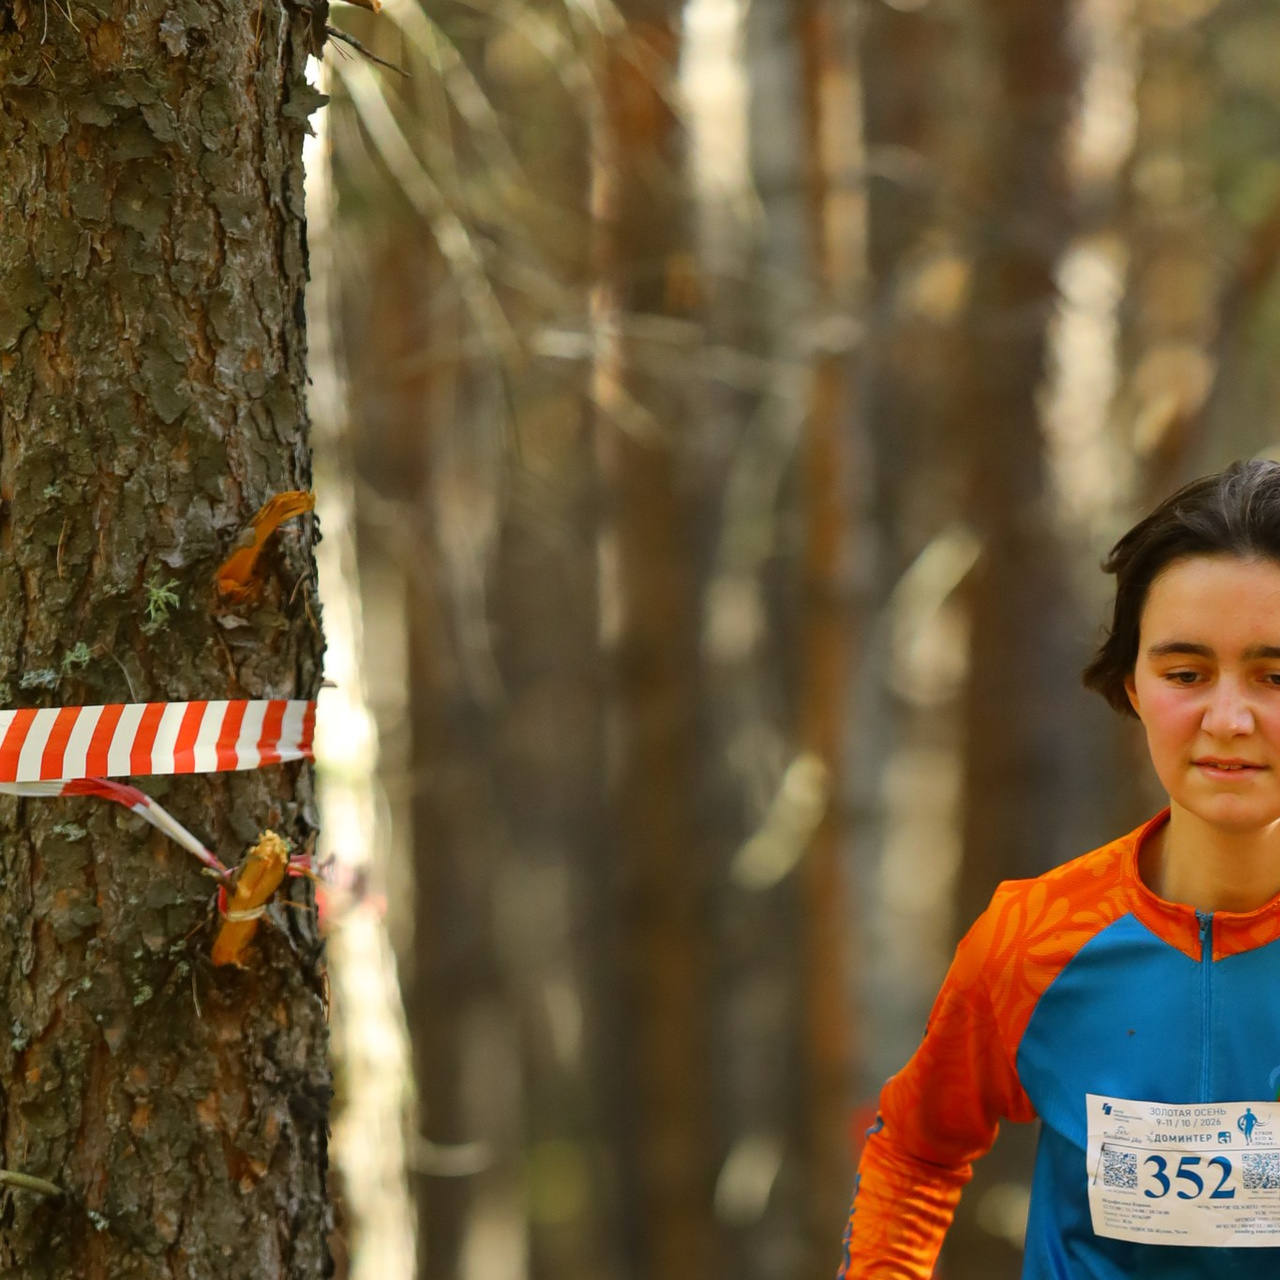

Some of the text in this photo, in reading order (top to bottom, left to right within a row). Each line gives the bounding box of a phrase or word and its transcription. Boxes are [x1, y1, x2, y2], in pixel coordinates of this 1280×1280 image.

[1149, 1107, 1192, 1117] ЗОЛОТАЯ
[1194, 1108, 1227, 1116] ОСЕНЬ
[1200, 1118, 1222, 1126] 2026
[1153, 1133, 1213, 1144] ДОМИНТЕР
[1143, 1154, 1236, 1200] 352
